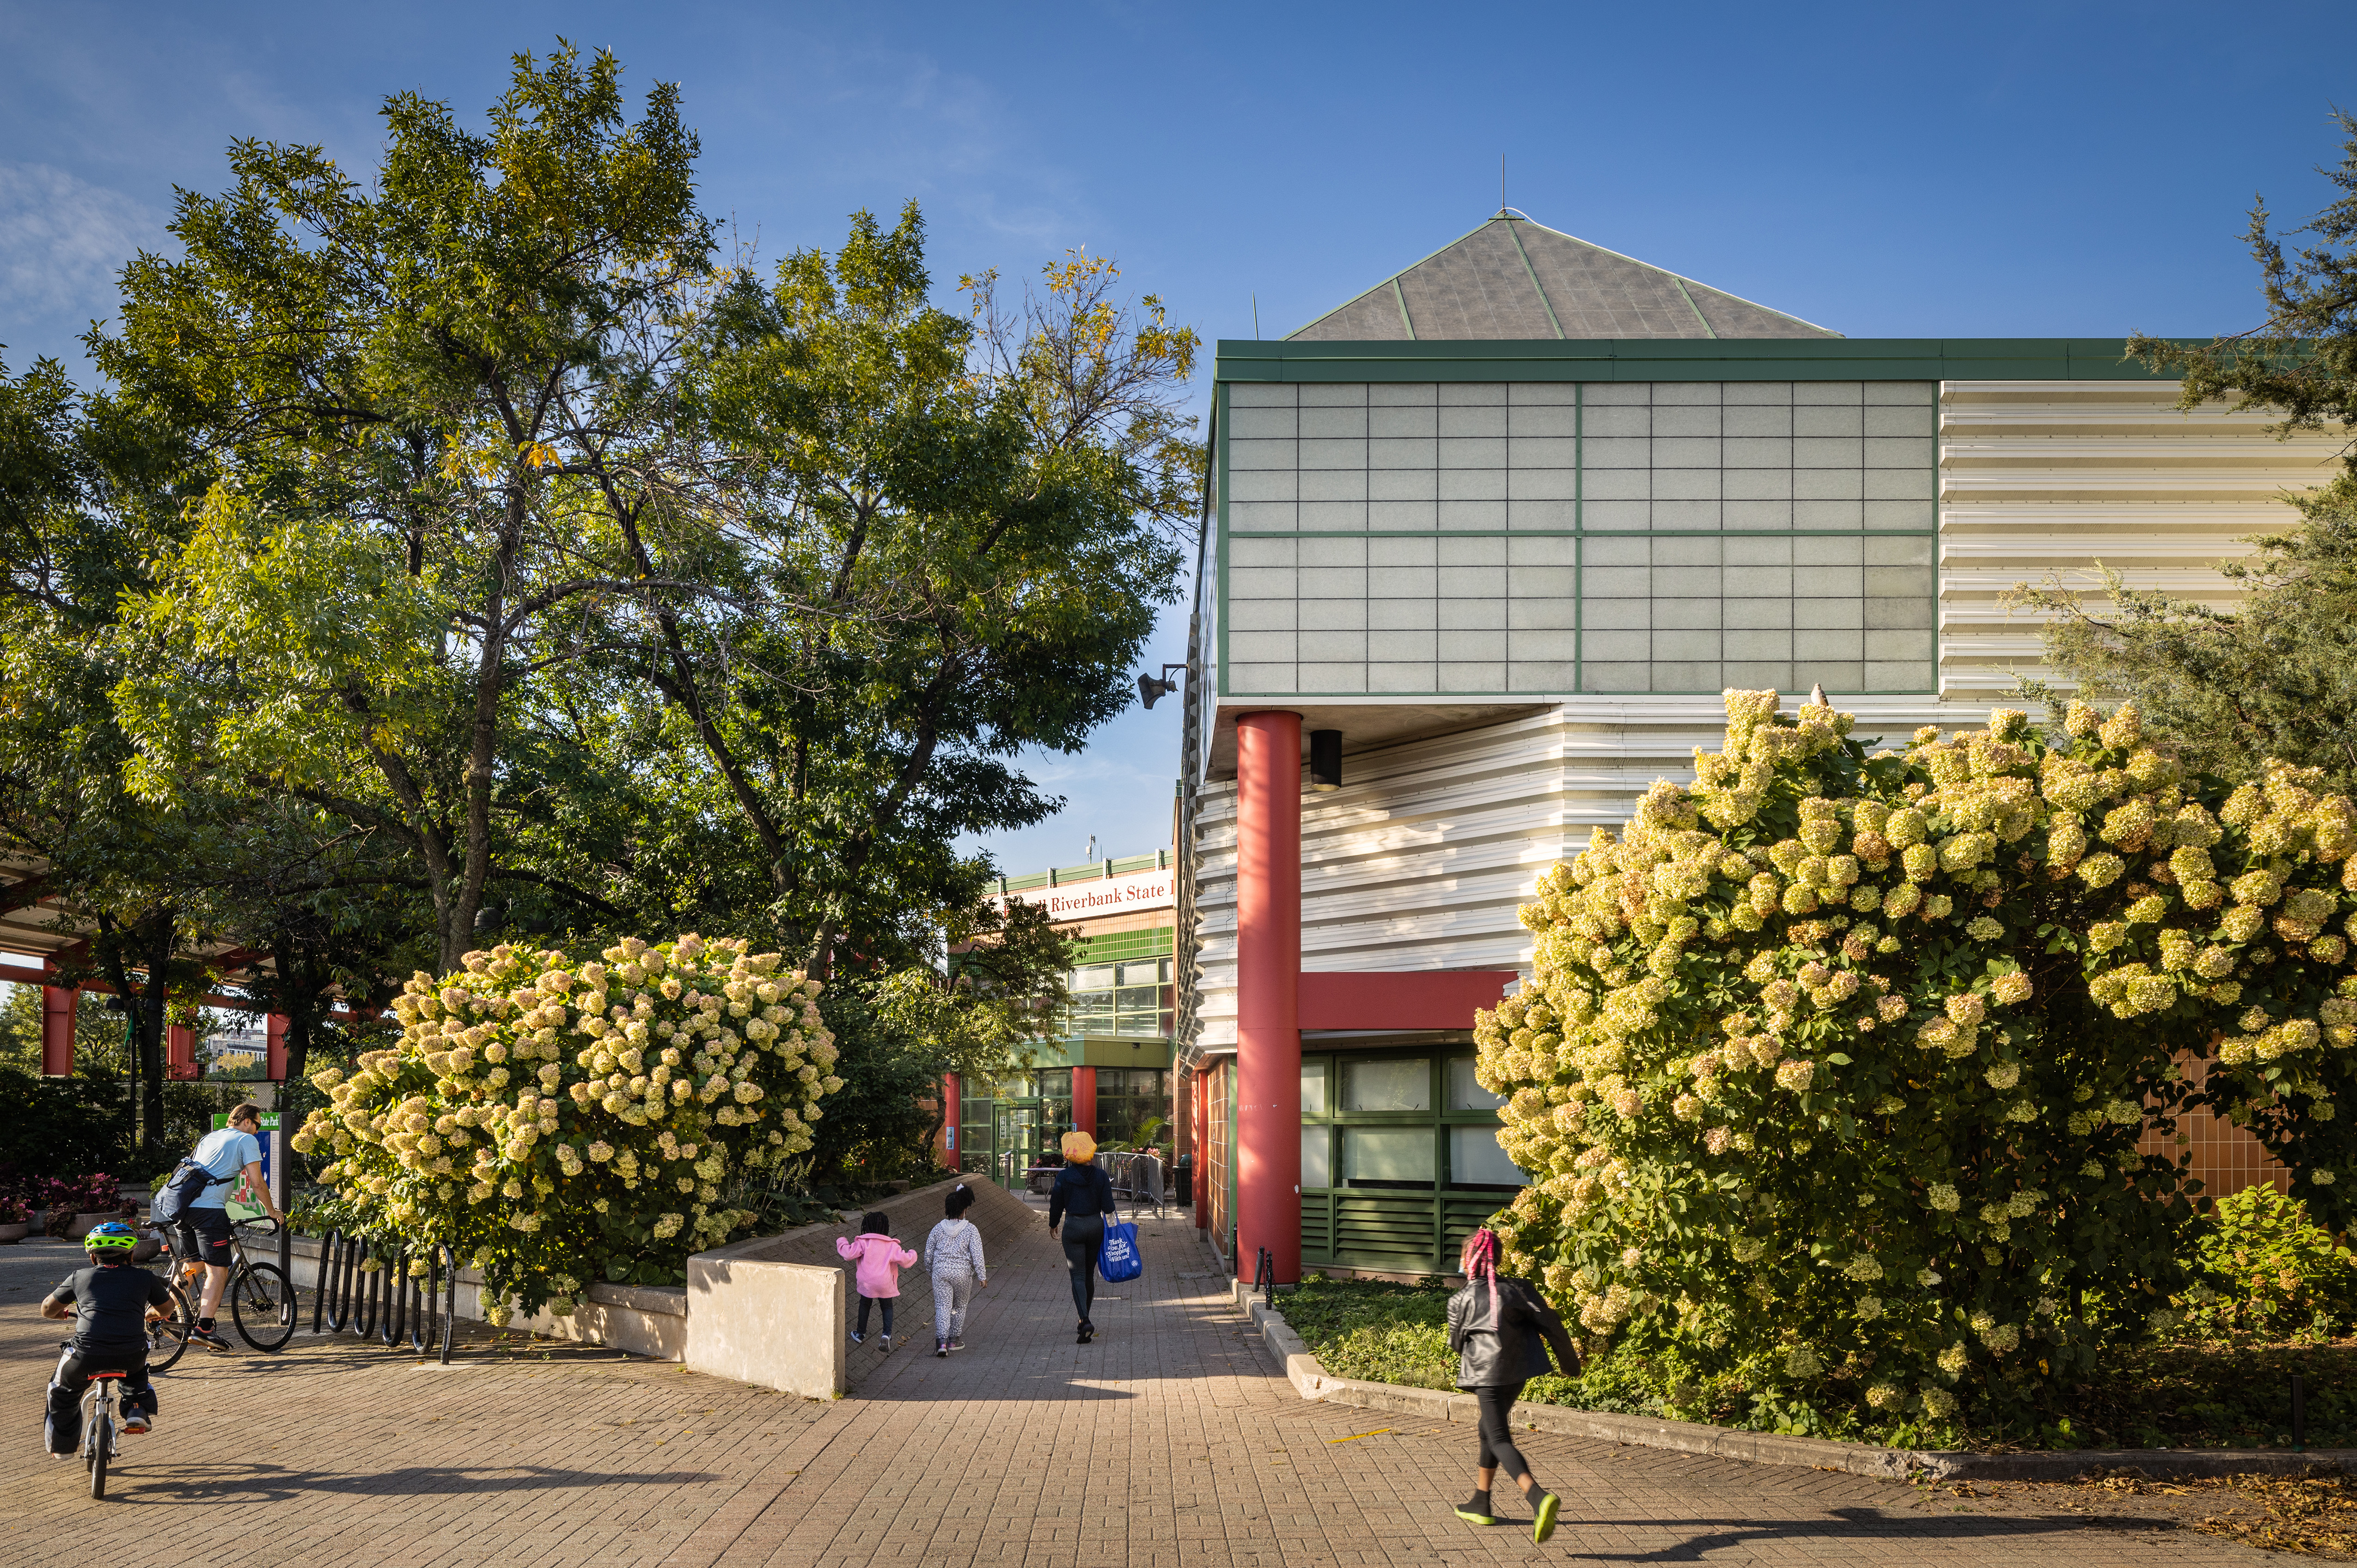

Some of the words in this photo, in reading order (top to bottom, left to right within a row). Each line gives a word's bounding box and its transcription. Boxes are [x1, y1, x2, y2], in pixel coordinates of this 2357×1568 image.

[1051, 888, 1122, 912] Riverbank
[1127, 884, 1164, 901] State
[260, 1117, 269, 1126] State
[270, 1115, 279, 1126] Park
[1109, 1237, 1125, 1245] Thank
[1117, 1242, 1127, 1251] for
[1105, 1246, 1130, 1258] Shopping
